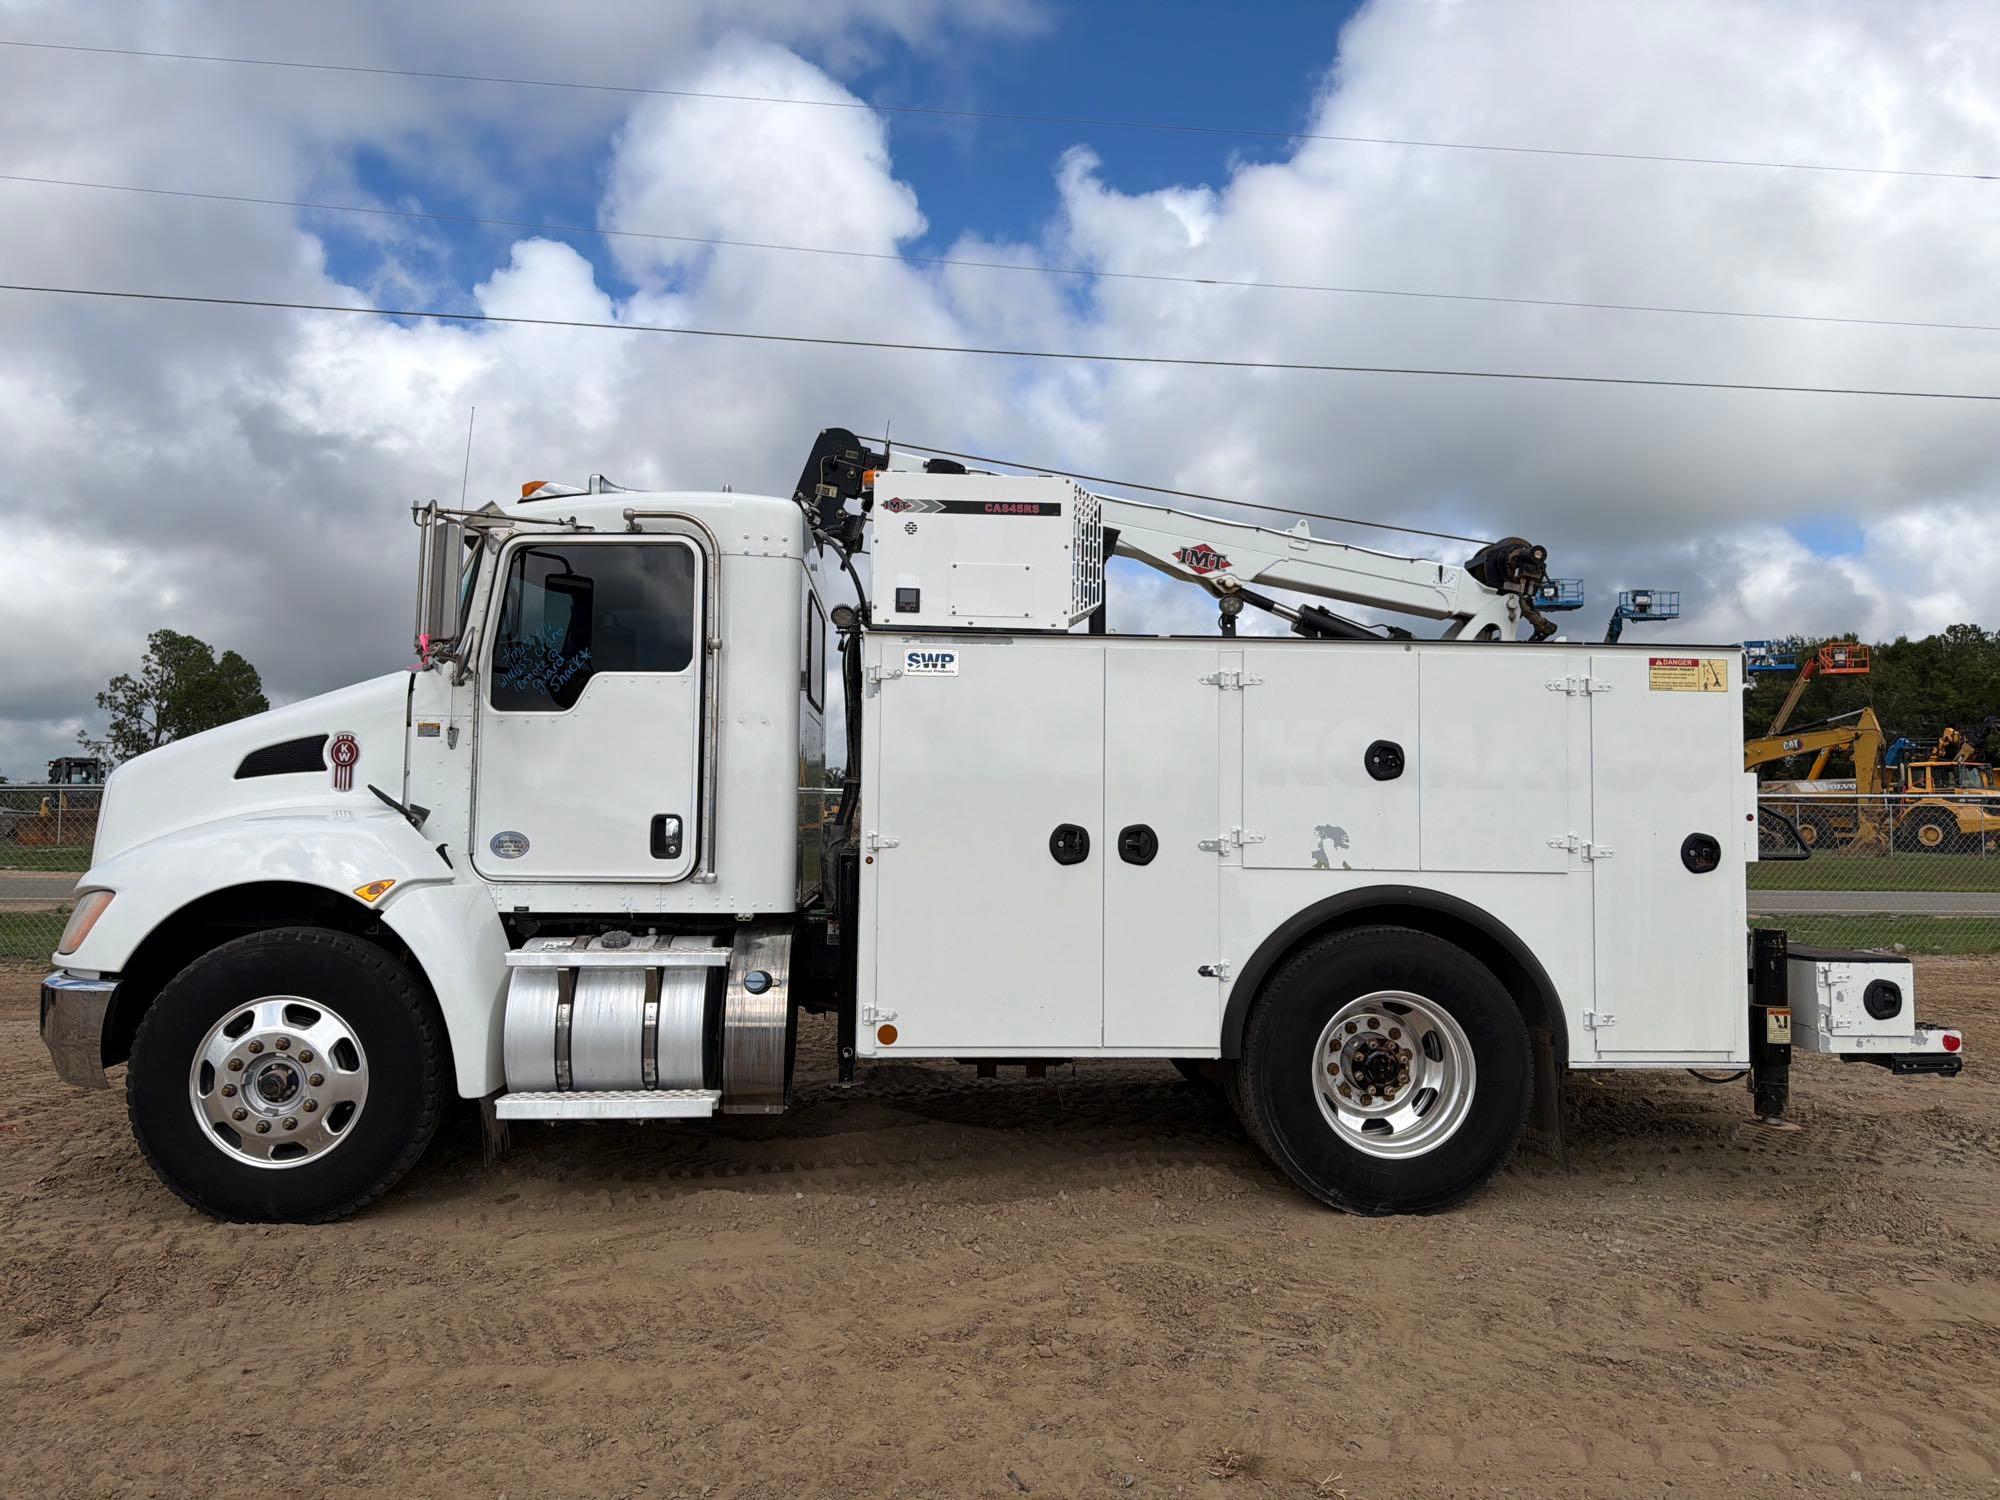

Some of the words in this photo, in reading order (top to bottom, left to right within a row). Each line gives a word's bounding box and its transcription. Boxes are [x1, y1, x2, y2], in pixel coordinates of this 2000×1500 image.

[884, 500, 908, 510] IMT
[1178, 546, 1227, 571] IMT
[907, 652, 955, 669] SWP
[1783, 740, 1799, 751] CAT
[1824, 782, 1856, 791] VOLVO
